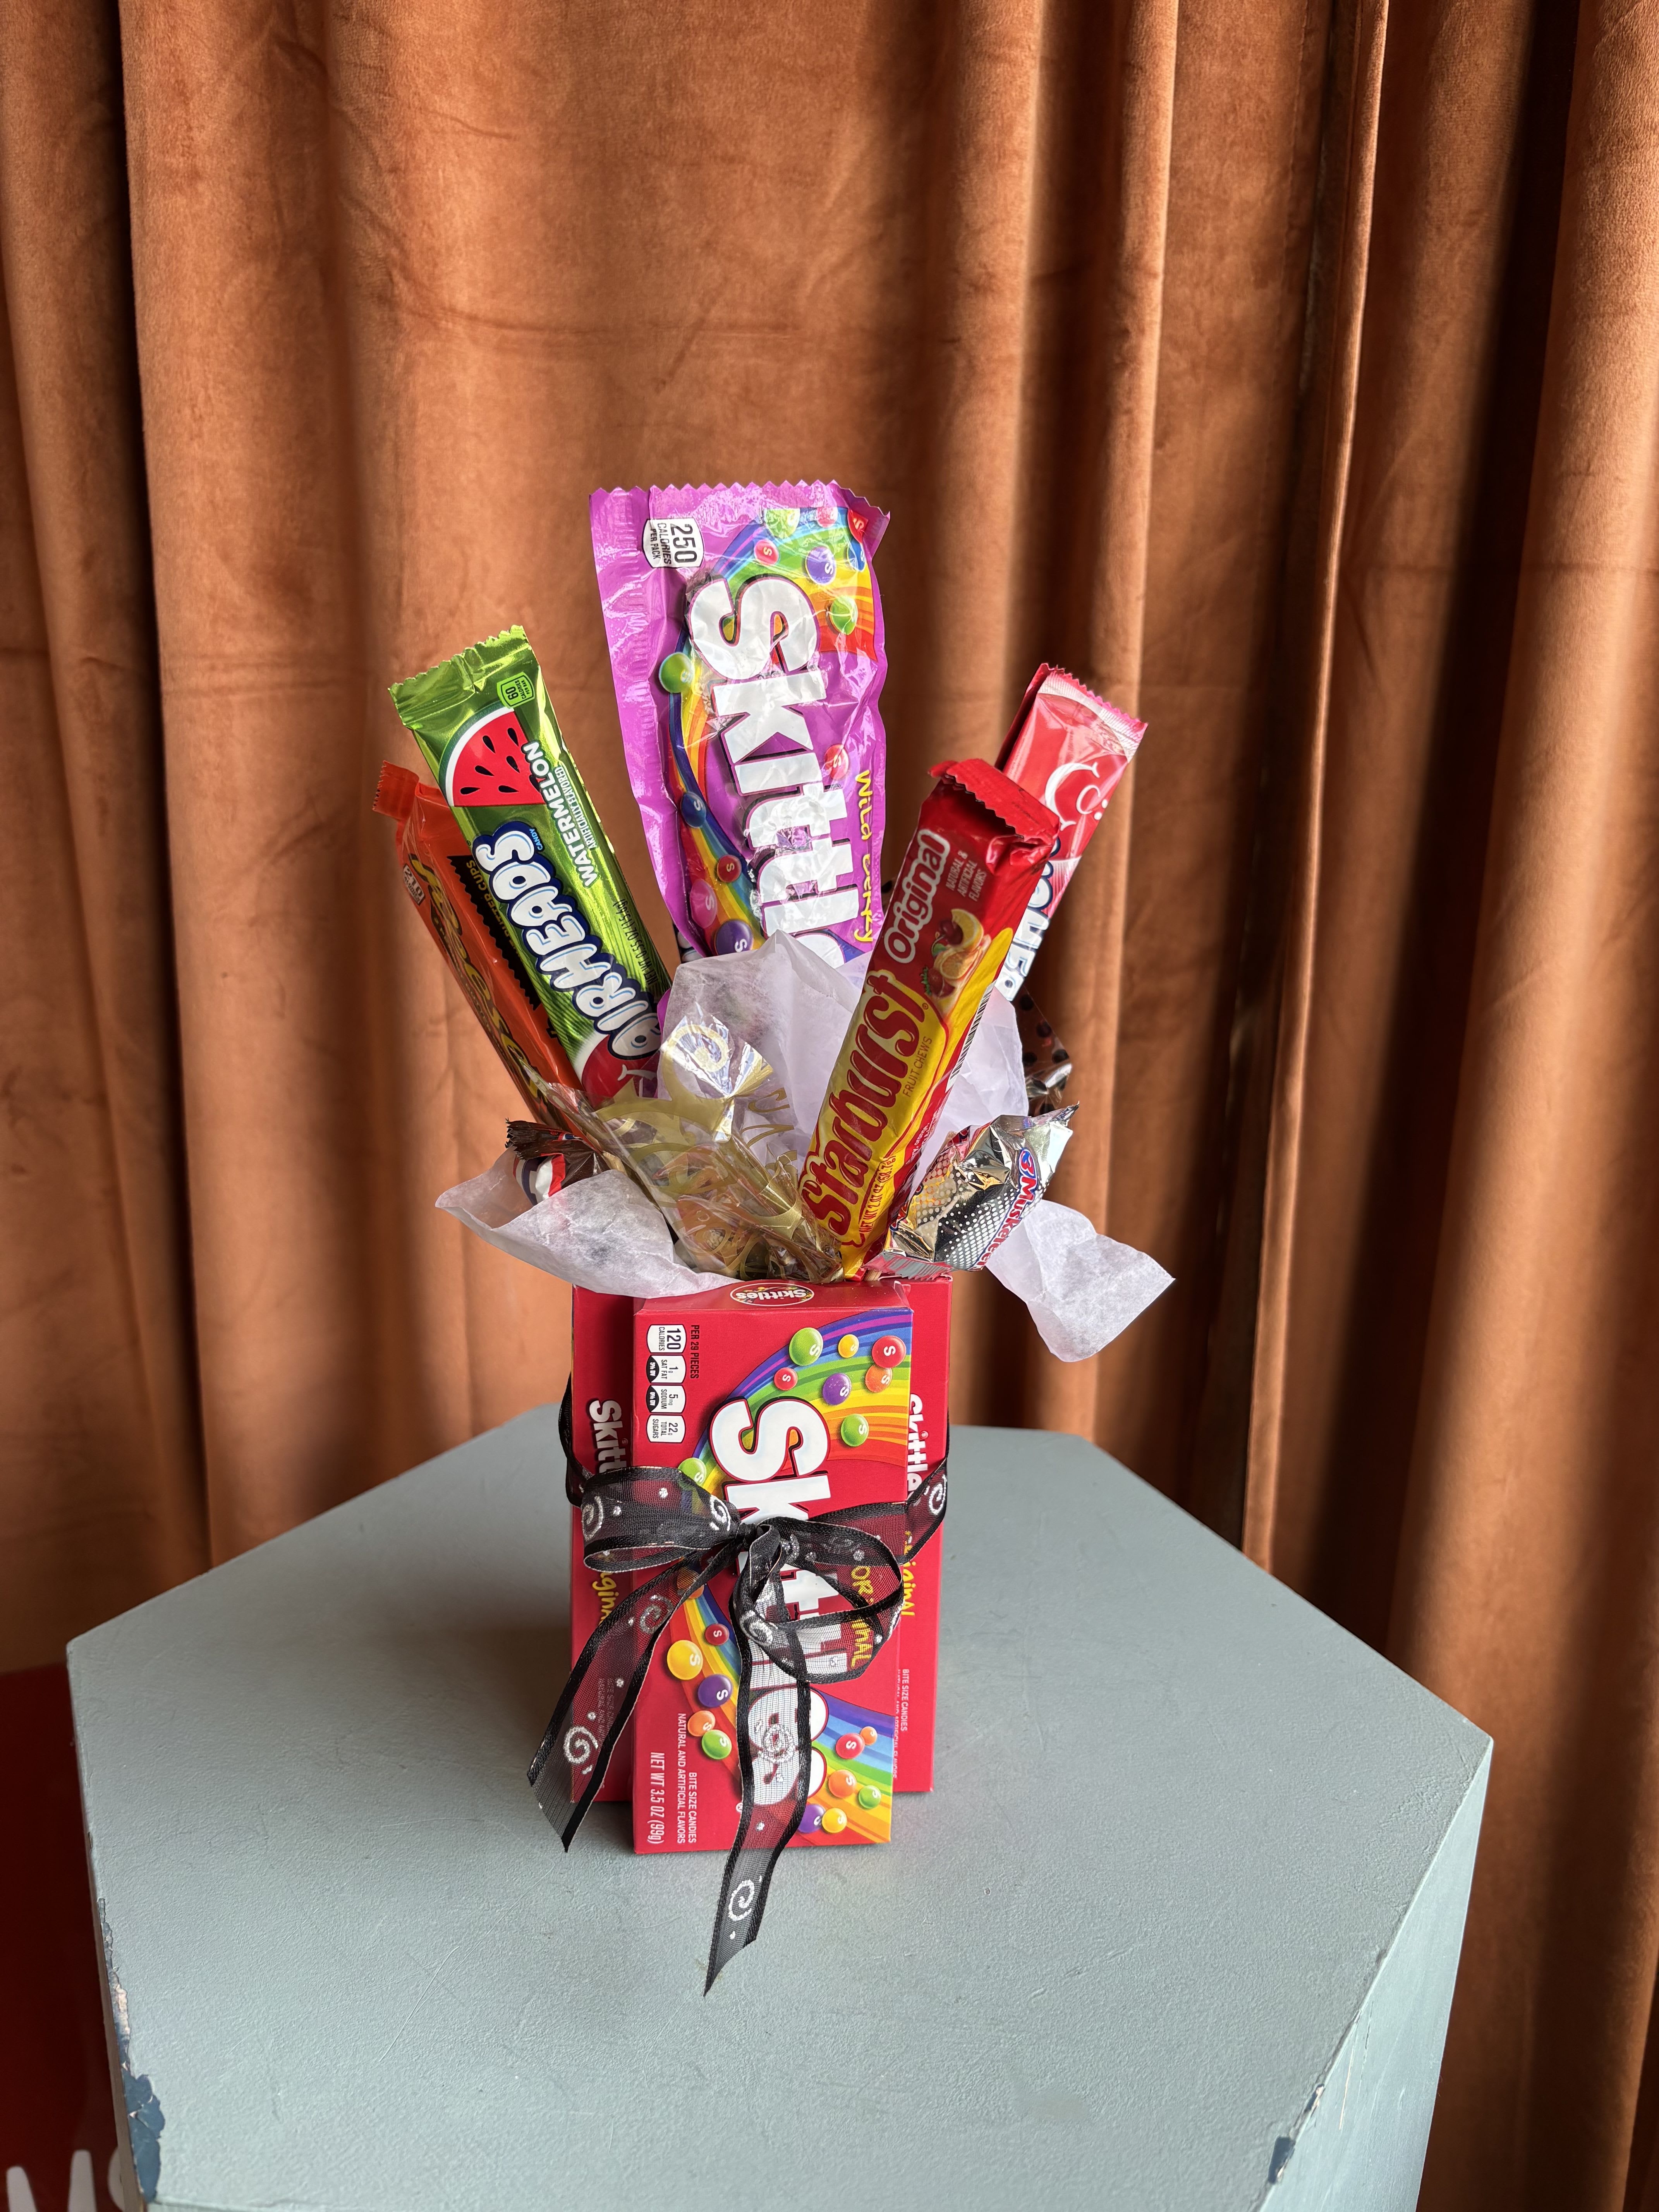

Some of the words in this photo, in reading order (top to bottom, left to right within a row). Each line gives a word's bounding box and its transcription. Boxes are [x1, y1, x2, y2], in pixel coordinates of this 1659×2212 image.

[651, 543, 661, 559] PACK
[657, 522, 672, 565] CALORIES
[670, 523, 697, 563] 250
[505, 686, 519, 700] 60
[515, 680, 527, 699] CALORIES
[554, 766, 579, 805] FLAVORED
[690, 577, 860, 969] Skittl
[523, 741, 598, 887] WATERMELON
[571, 805, 597, 849] ARTIFICIALLY
[529, 829, 543, 850] CANDY
[404, 868, 423, 896] 210
[466, 860, 487, 891] CUPS
[945, 858, 964, 891] NATURAL
[957, 850, 968, 859] &
[957, 860, 978, 898] ARTIFICIAL
[886, 831, 948, 962] Original
[968, 868, 987, 902] FLAVORS
[476, 830, 661, 1056] AIRHEADS
[625, 927, 639, 941] OZ
[630, 939, 647, 959] 0.55
[643, 969, 658, 985] NET
[903, 1065, 921, 1097] FRUIT
[913, 1036, 933, 1069] CHEWS
[802, 974, 925, 1236] Starburst
[1020, 1149, 1036, 1176] 3
[859, 1221, 873, 1233] NET
[863, 1209, 878, 1221] WT
[736, 1289, 807, 1300] Skittles
[666, 1328, 682, 1350] 120
[690, 1341, 699, 1350] 29
[691, 1325, 700, 1339] PER
[690, 1353, 699, 1379] PIECES
[589, 1400, 627, 1474] Skitt
[907, 1394, 928, 1500] Skittle
[900, 1702, 908, 1731] CANDIES
[677, 1713, 686, 1748] NATURAL
[651, 1752, 665, 1771] NET
[677, 1750, 686, 1767] AND
[651, 1772, 665, 1787] WT
[677, 1768, 686, 1810] ARTIFICIAL
[689, 1772, 697, 1790] BITE
[651, 1789, 665, 1803] 3.5
[689, 1791, 697, 1809] SIZE
[651, 1806, 665, 1818] OZ
[647, 1820, 665, 1844] (99g)
[677, 1812, 685, 1844] FLAVORS
[688, 1811, 697, 1843] CANDIES
